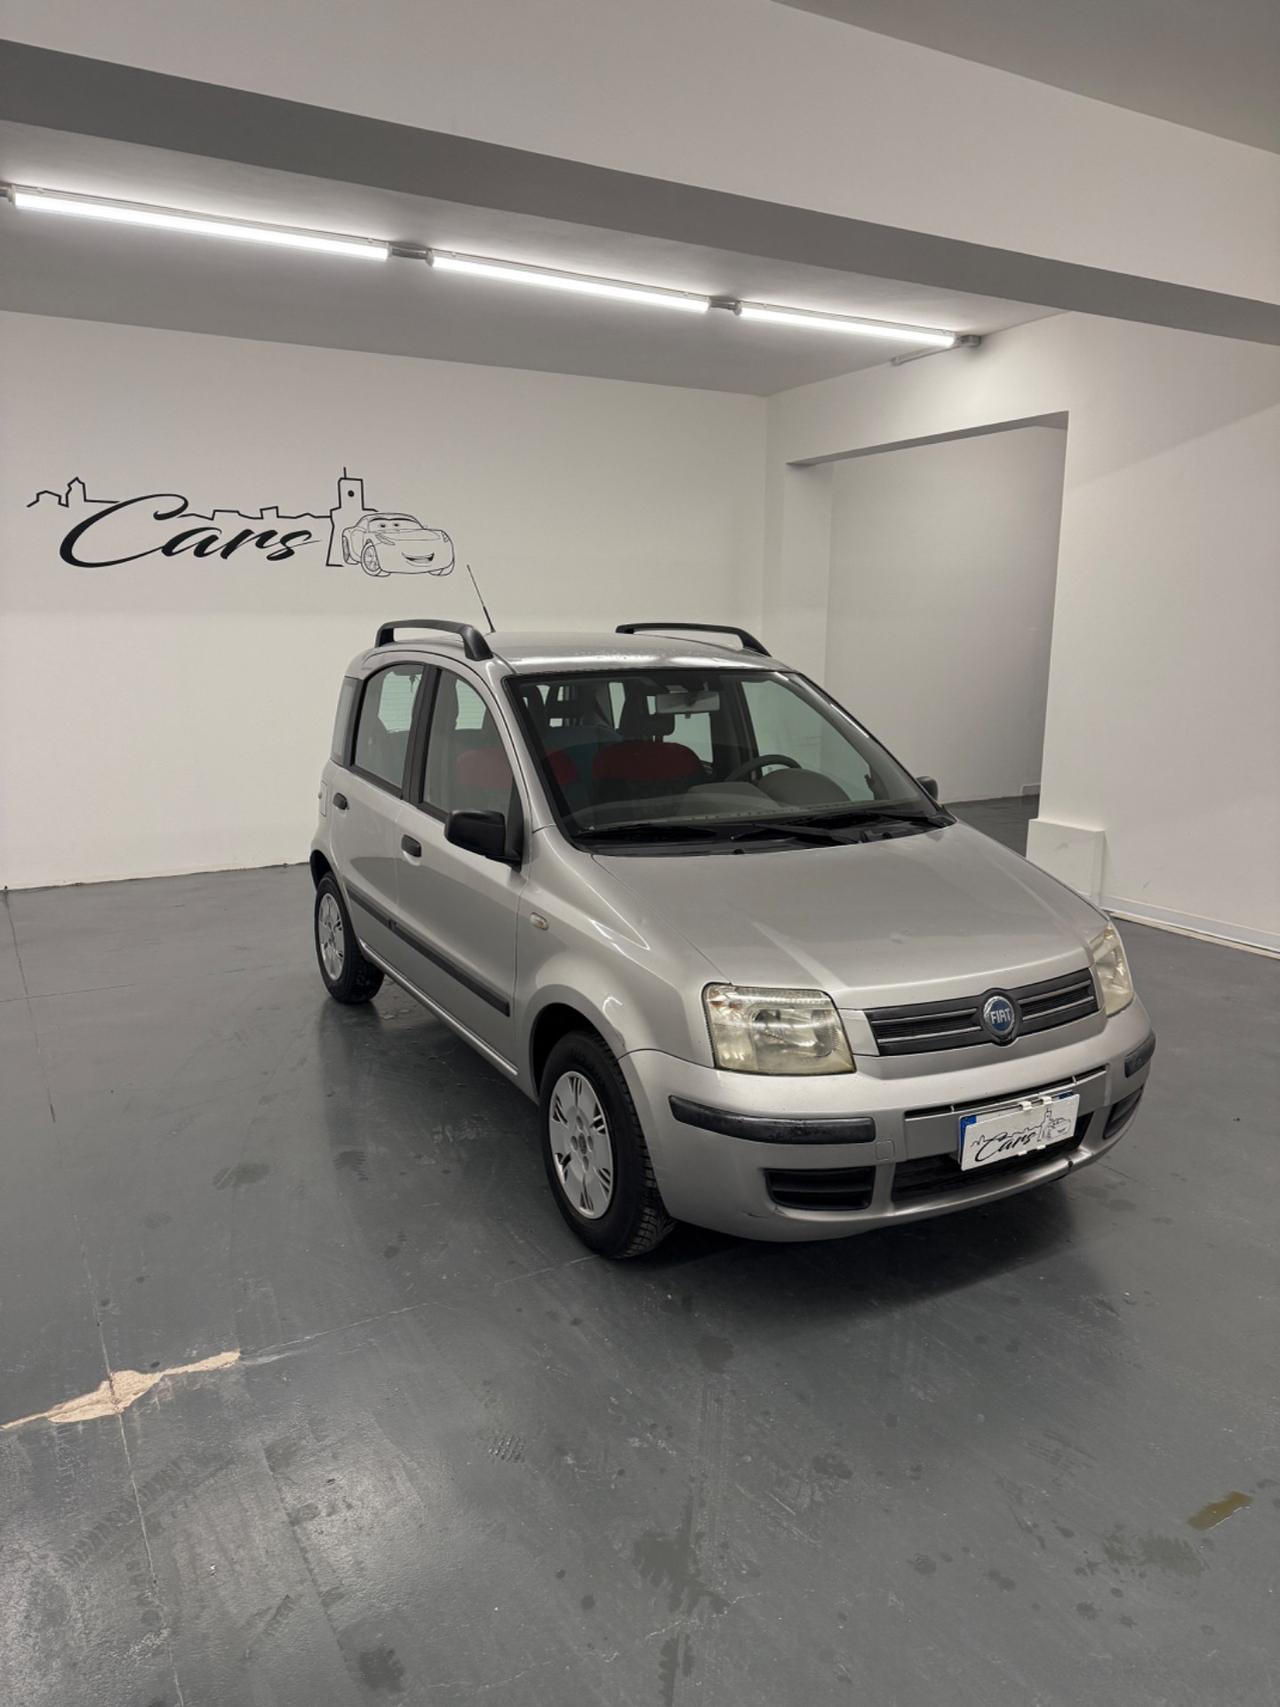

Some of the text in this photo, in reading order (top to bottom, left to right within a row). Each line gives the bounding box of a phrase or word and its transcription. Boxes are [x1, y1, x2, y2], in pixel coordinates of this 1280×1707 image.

[59, 493, 314, 568] Cars
[990, 1008, 1011, 1025] FIAT
[975, 1131, 1036, 1162] Cars
